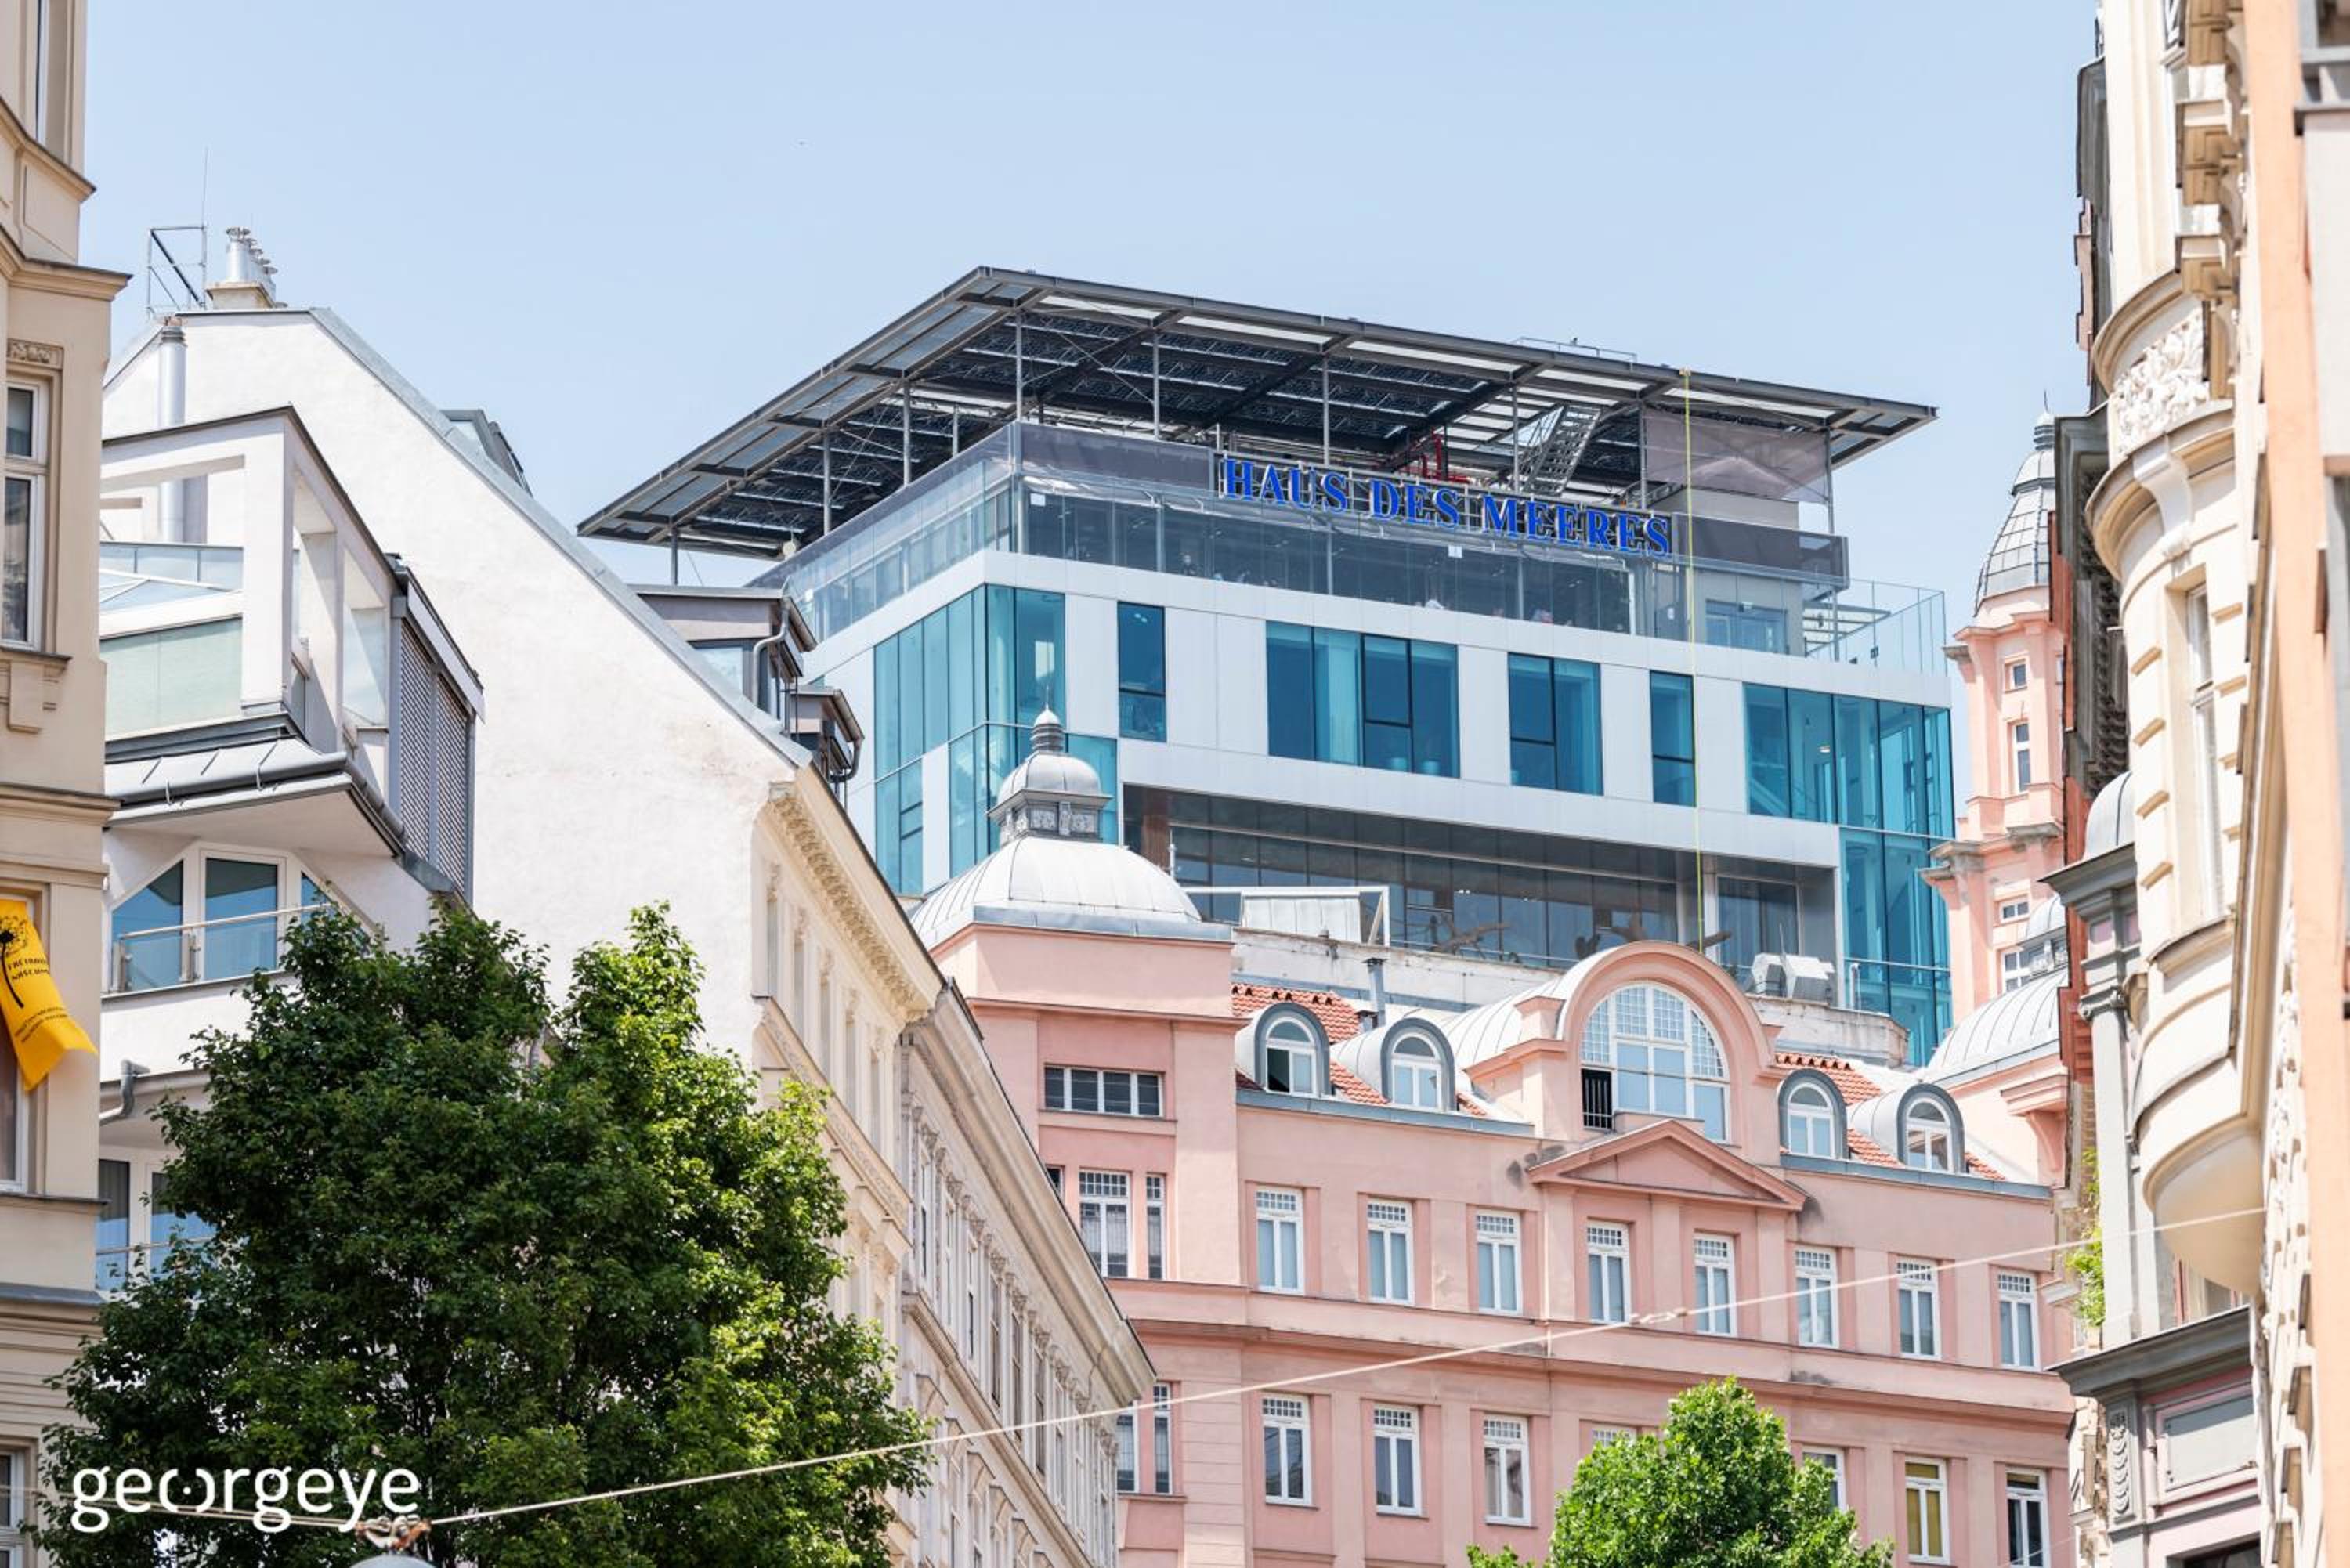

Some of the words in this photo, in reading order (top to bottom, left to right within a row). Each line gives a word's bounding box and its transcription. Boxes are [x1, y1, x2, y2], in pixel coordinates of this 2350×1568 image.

[1223, 457, 1348, 513] HAUS
[1370, 479, 1461, 529] DES
[1481, 494, 1672, 558] MEERES
